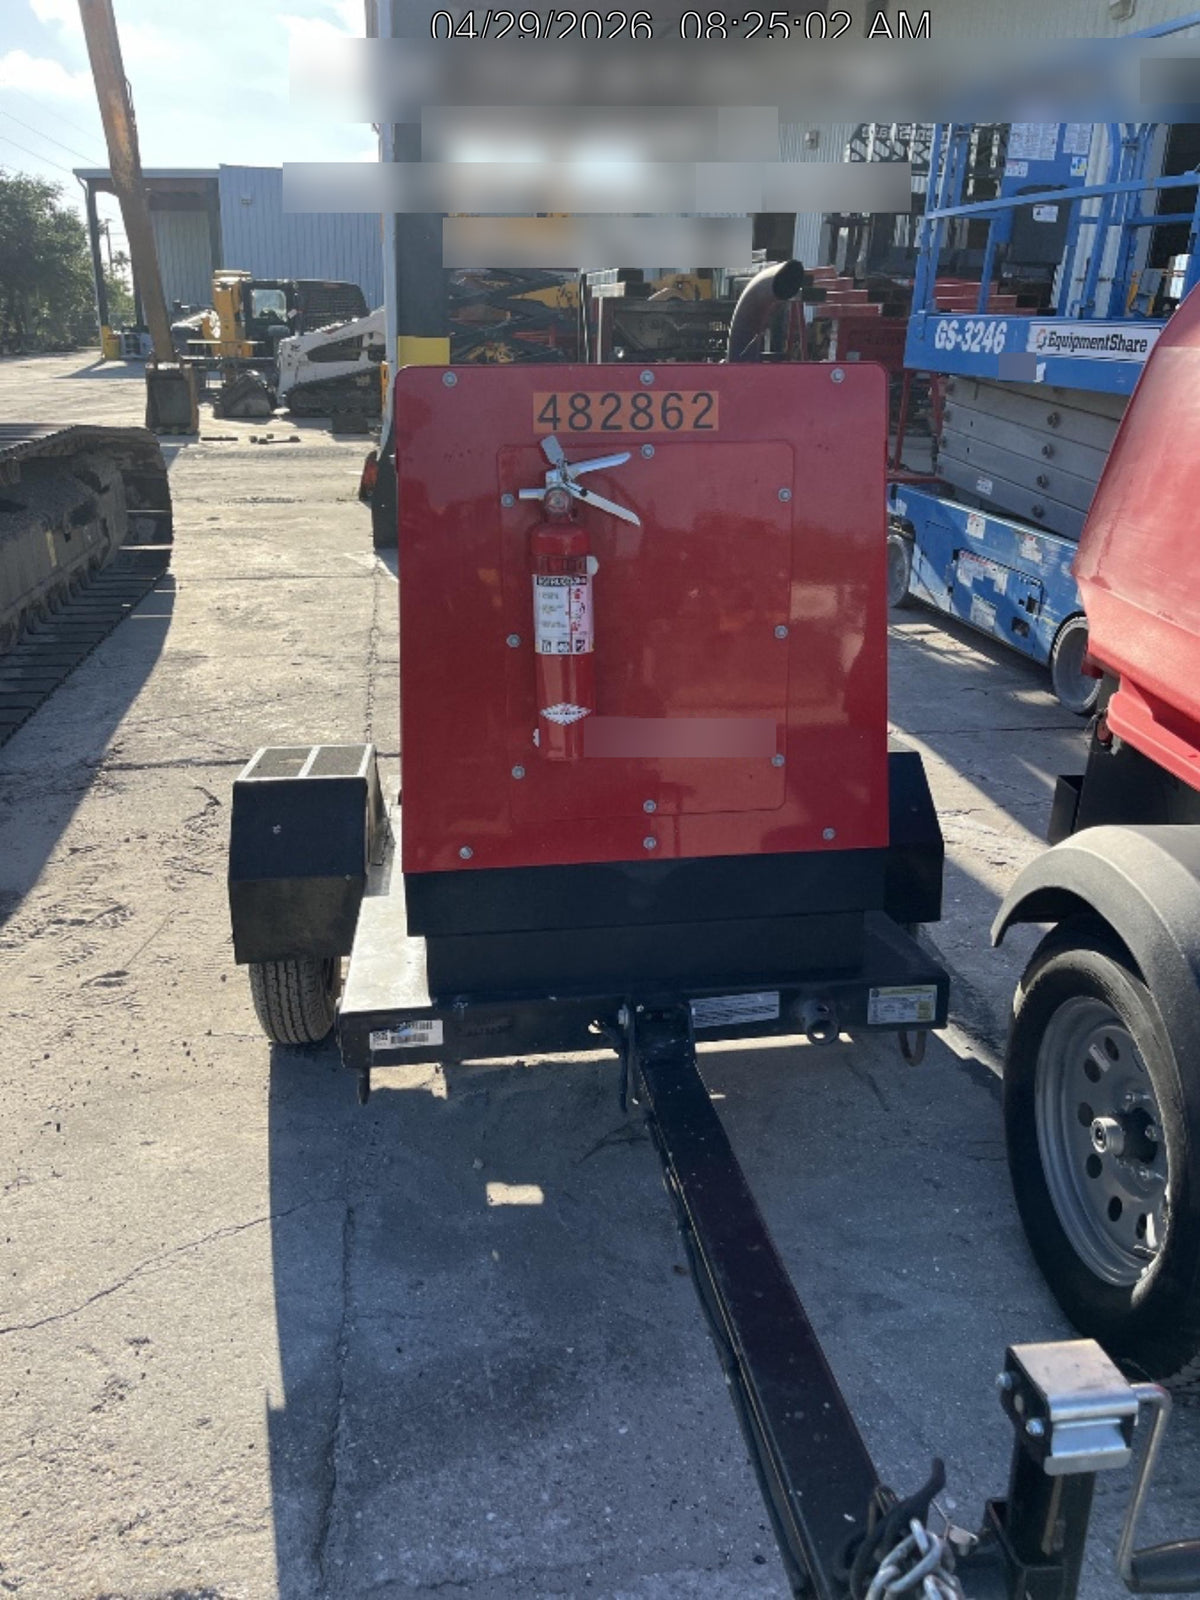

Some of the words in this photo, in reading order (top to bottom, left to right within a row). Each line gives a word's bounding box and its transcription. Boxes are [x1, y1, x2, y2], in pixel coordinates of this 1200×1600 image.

[934, 319, 1008, 354] GS-3246
[1047, 331, 1148, 353] EquipmentShare
[537, 392, 714, 431] 482862
